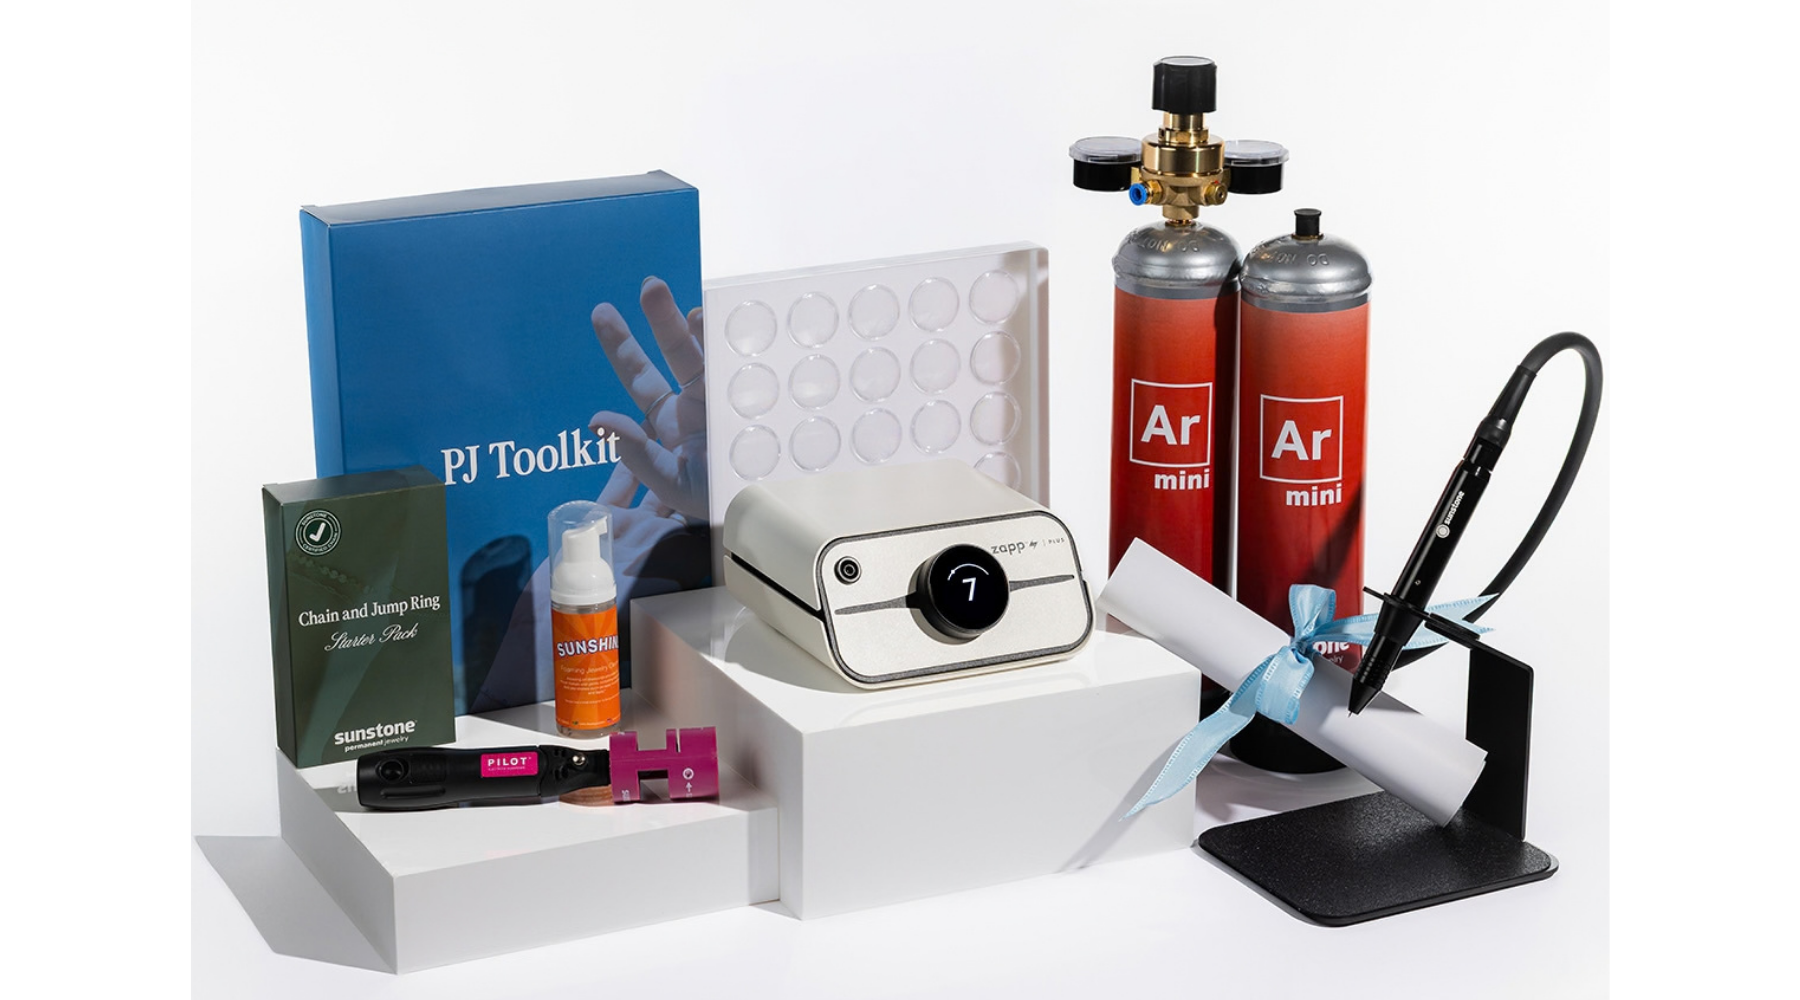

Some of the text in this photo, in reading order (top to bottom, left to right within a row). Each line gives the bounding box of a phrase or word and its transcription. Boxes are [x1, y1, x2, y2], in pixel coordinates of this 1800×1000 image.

[1140, 404, 1200, 445] Ar
[1271, 420, 1332, 461] Ar
[440, 427, 622, 486] PJ Toolkit
[1154, 468, 1210, 490] mini
[1286, 482, 1342, 506] mini
[1444, 490, 1465, 525] sunstone
[991, 541, 1026, 555] zapp
[962, 577, 977, 602] 7
[298, 594, 441, 627] Chain and Jump Ring
[323, 622, 419, 652] Starter Pack
[334, 720, 416, 745] sunstone
[344, 736, 409, 753] permanent jewelry
[487, 757, 528, 767] PILOT
